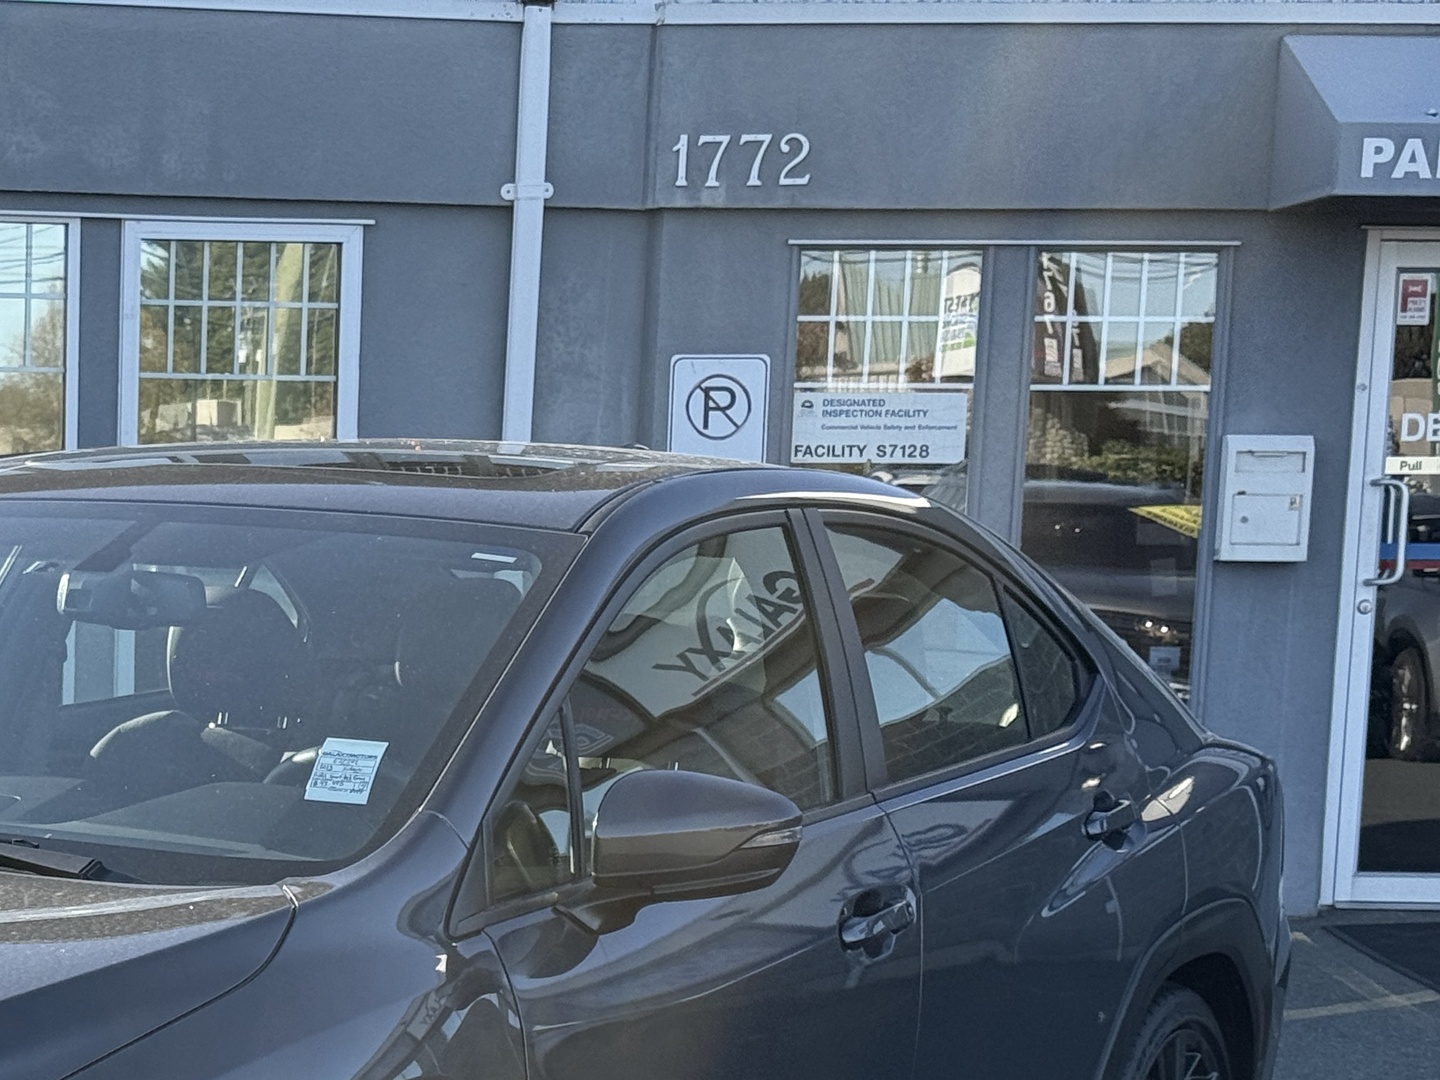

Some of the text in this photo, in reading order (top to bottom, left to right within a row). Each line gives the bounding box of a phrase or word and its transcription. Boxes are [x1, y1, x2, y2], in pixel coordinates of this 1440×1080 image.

[672, 133, 811, 187] 1772
[1360, 137, 1440, 179] PA
[822, 398, 886, 407] DESIGNATED
[821, 409, 882, 418] INSPECTION
[884, 409, 929, 418] FACILITY
[883, 424, 903, 432] Safety
[794, 444, 930, 458] FACILITY S7128
[1400, 461, 1423, 471] Pull
